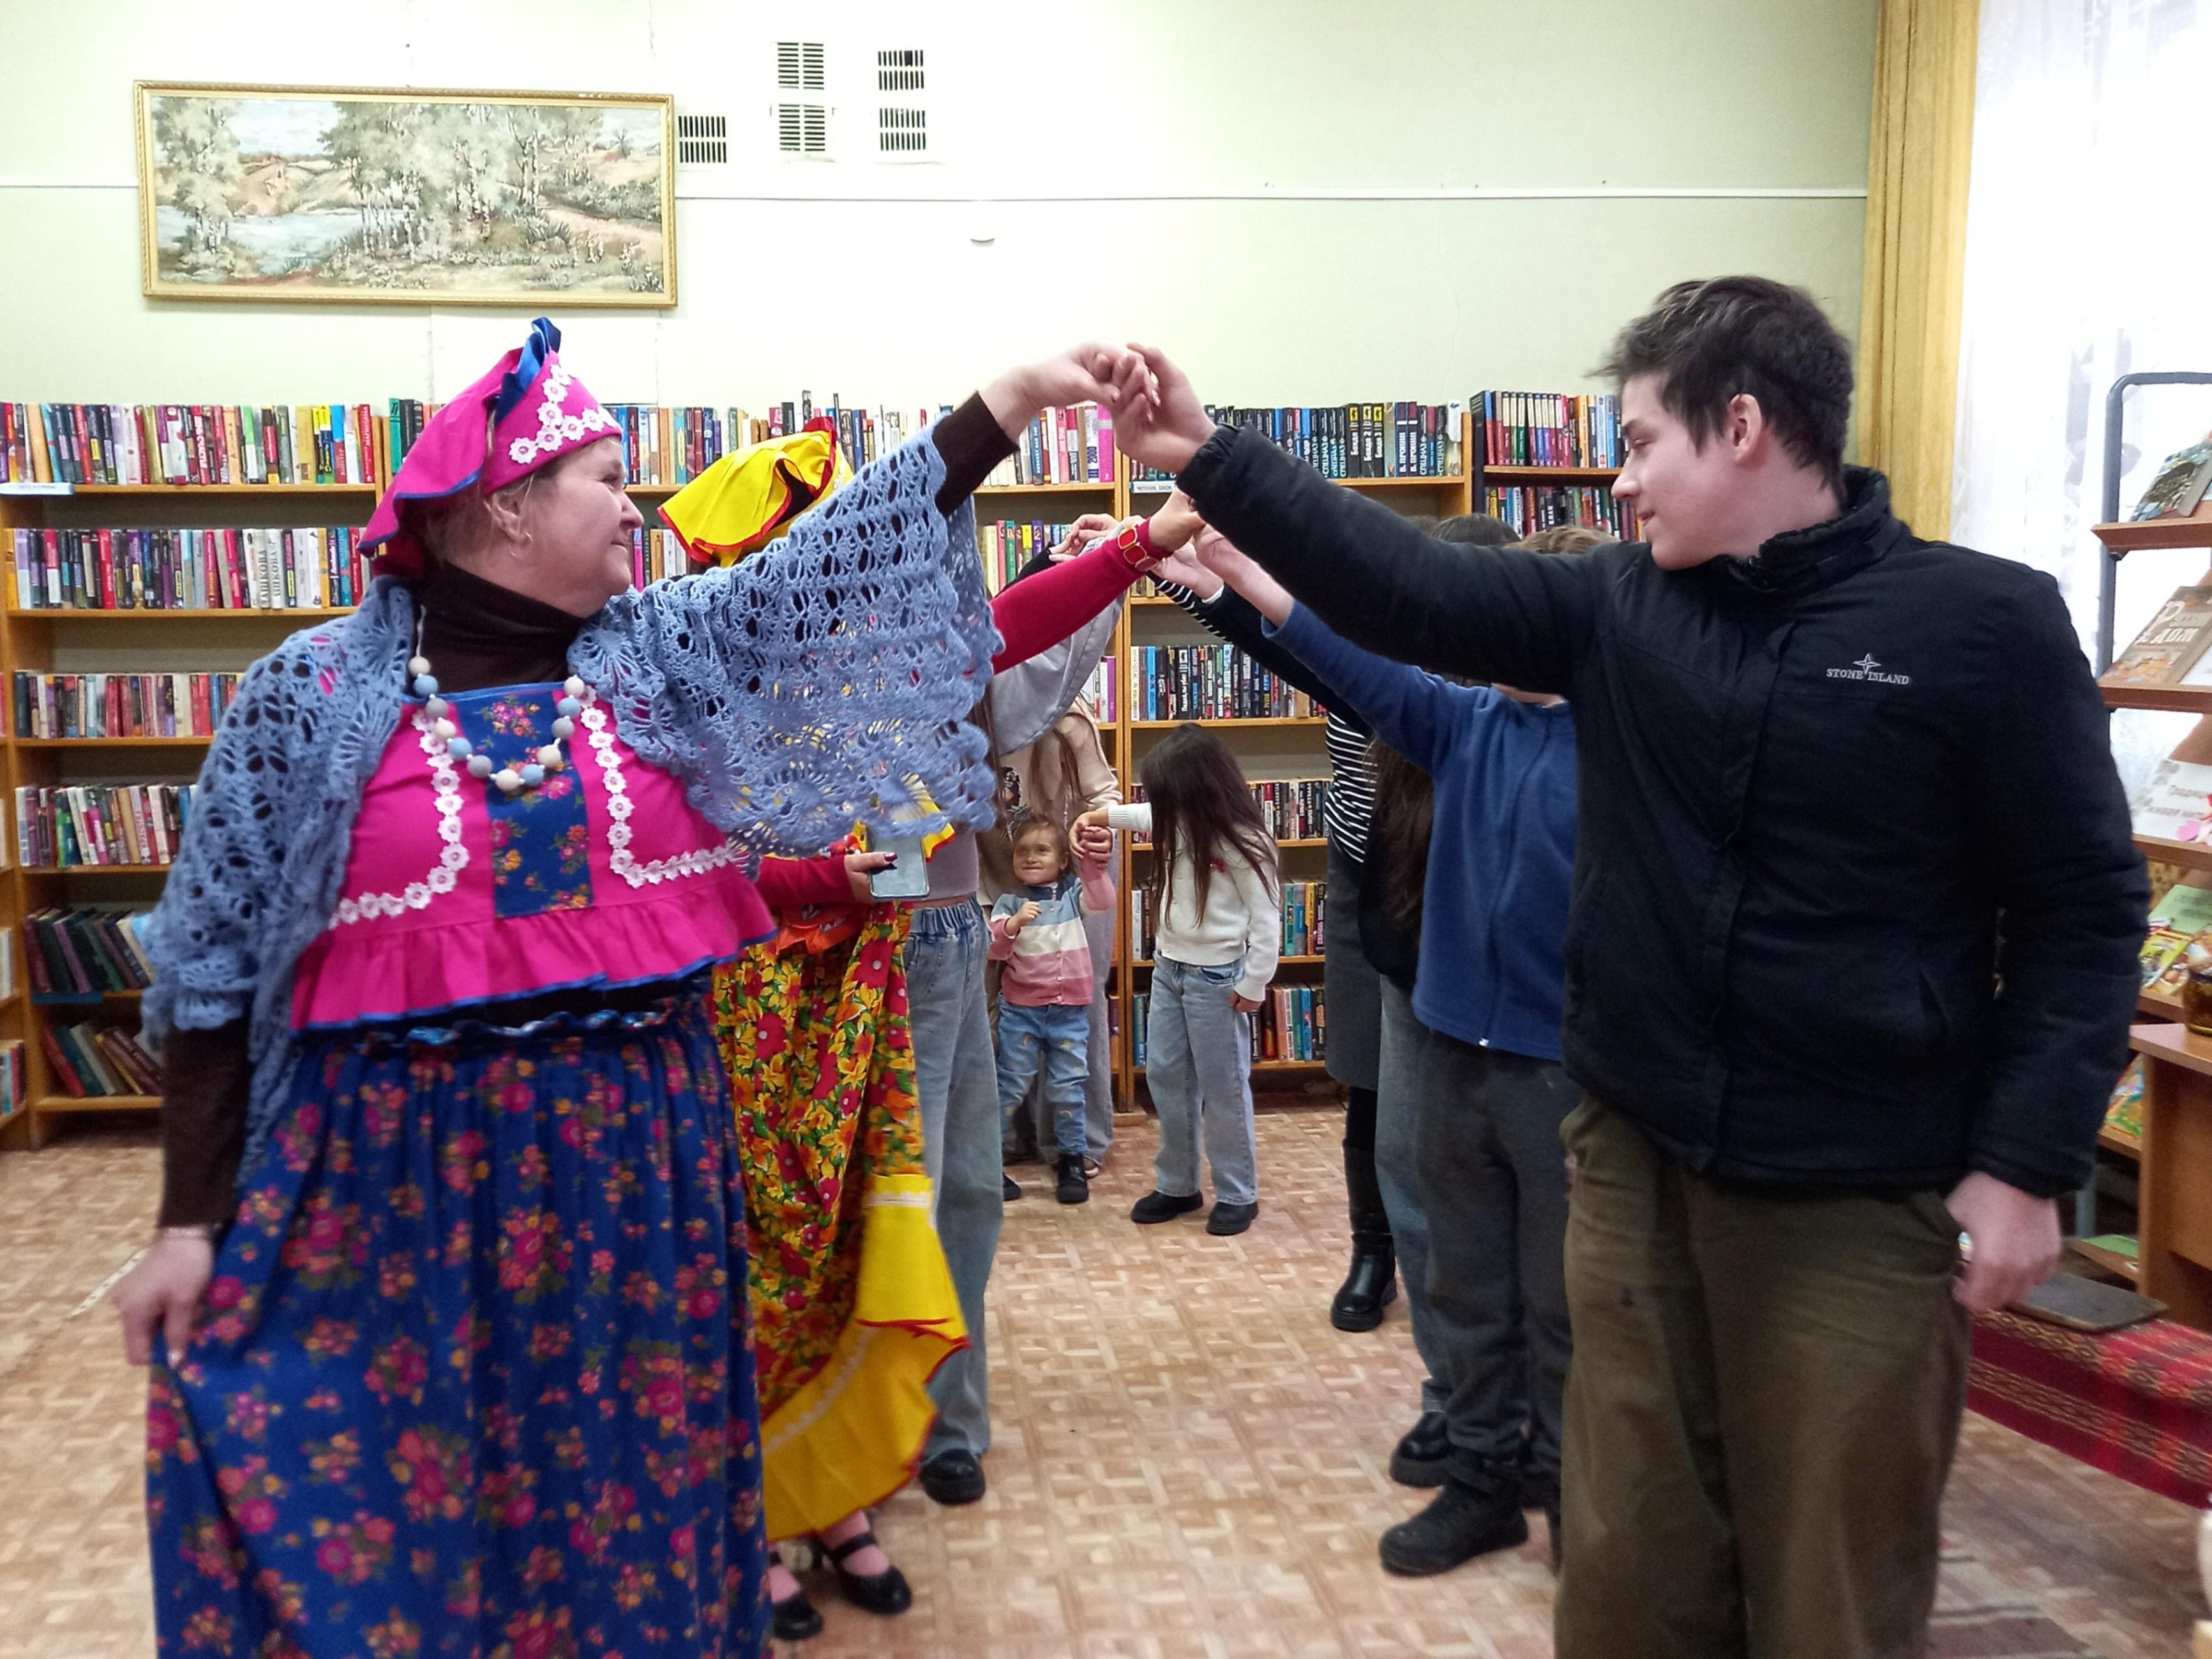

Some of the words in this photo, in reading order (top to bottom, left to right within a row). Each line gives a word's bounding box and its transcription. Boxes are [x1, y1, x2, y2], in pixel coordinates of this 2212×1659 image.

[1350, 432, 1358, 456] Банда
[1363, 437, 1372, 462] Банда
[1374, 437, 1383, 458] Банда
[1826, 668, 1863, 680] STONE
[1867, 671, 1909, 685] ISLAND
